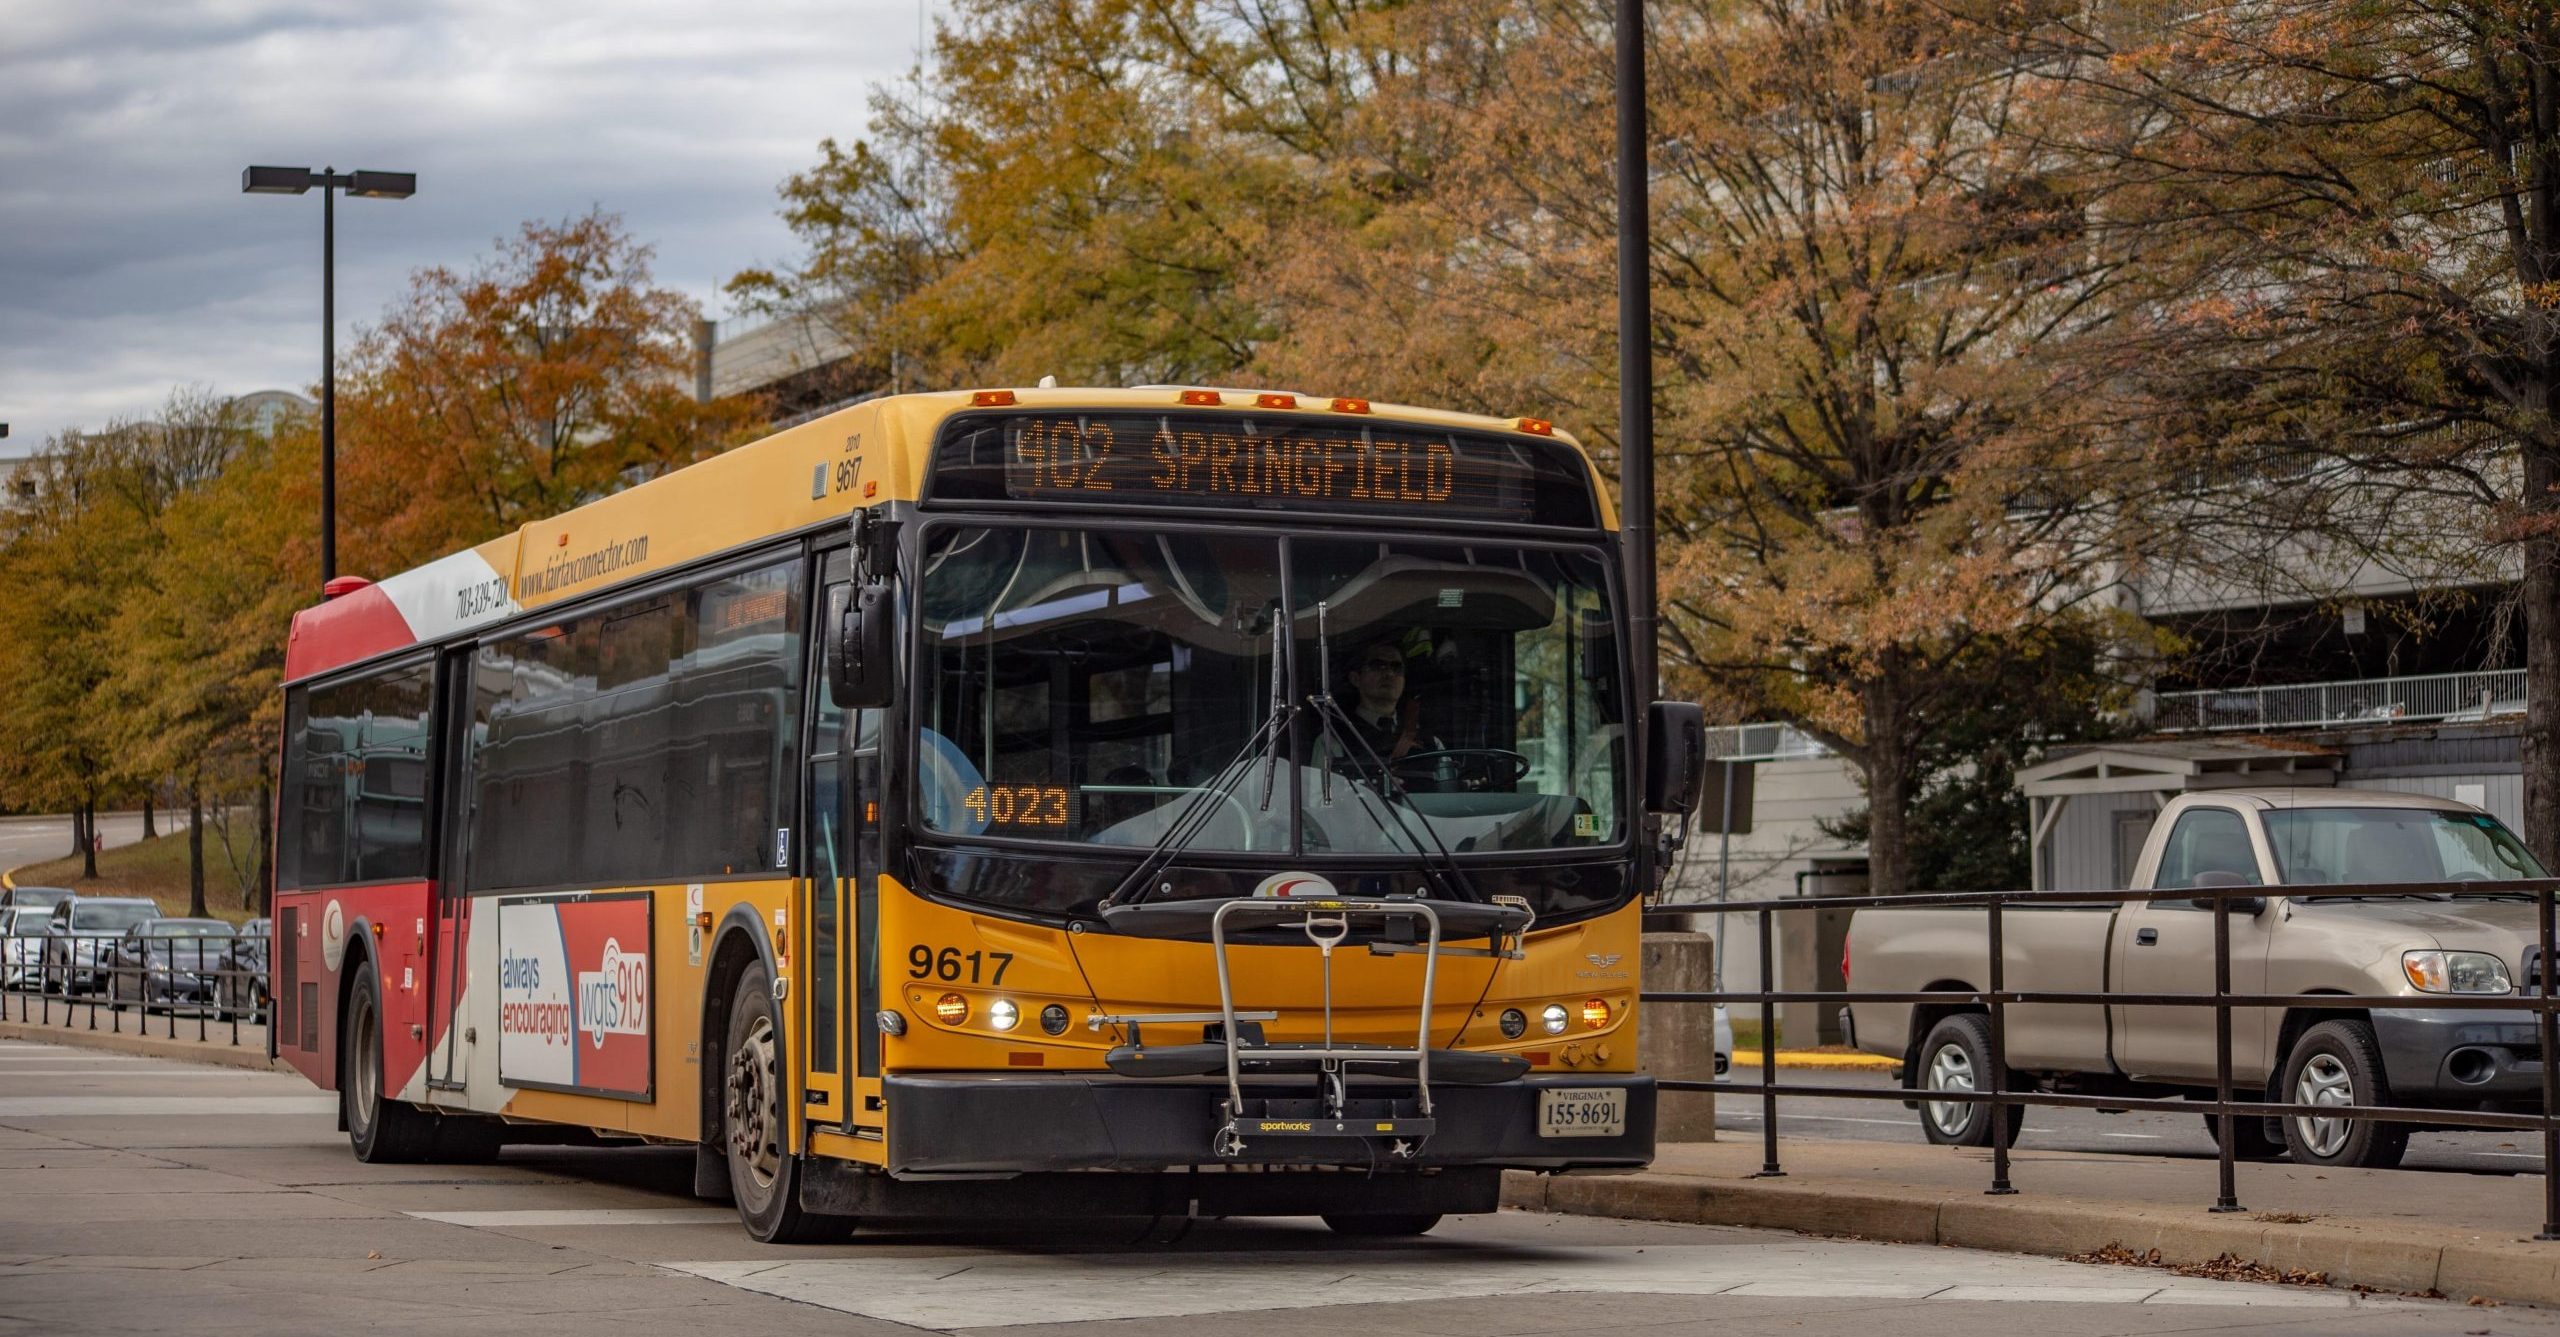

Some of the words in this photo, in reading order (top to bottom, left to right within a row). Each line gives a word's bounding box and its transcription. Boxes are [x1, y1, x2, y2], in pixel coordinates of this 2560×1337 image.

[836, 455, 863, 493] 9617
[1018, 419, 1113, 490] 402
[1151, 429, 1452, 501] SPRINGFIELD
[520, 535, 649, 600] www.fairfaxconnector.com
[964, 785, 1069, 825] 4023
[503, 948, 540, 999] always
[908, 944, 1014, 986] 9617
[503, 992, 569, 1046] encouraging
[1546, 1102, 1620, 1125] 155-869L
[1563, 1091, 1604, 1101] VIRGINIA
[1260, 1121, 1311, 1132] sportworks
